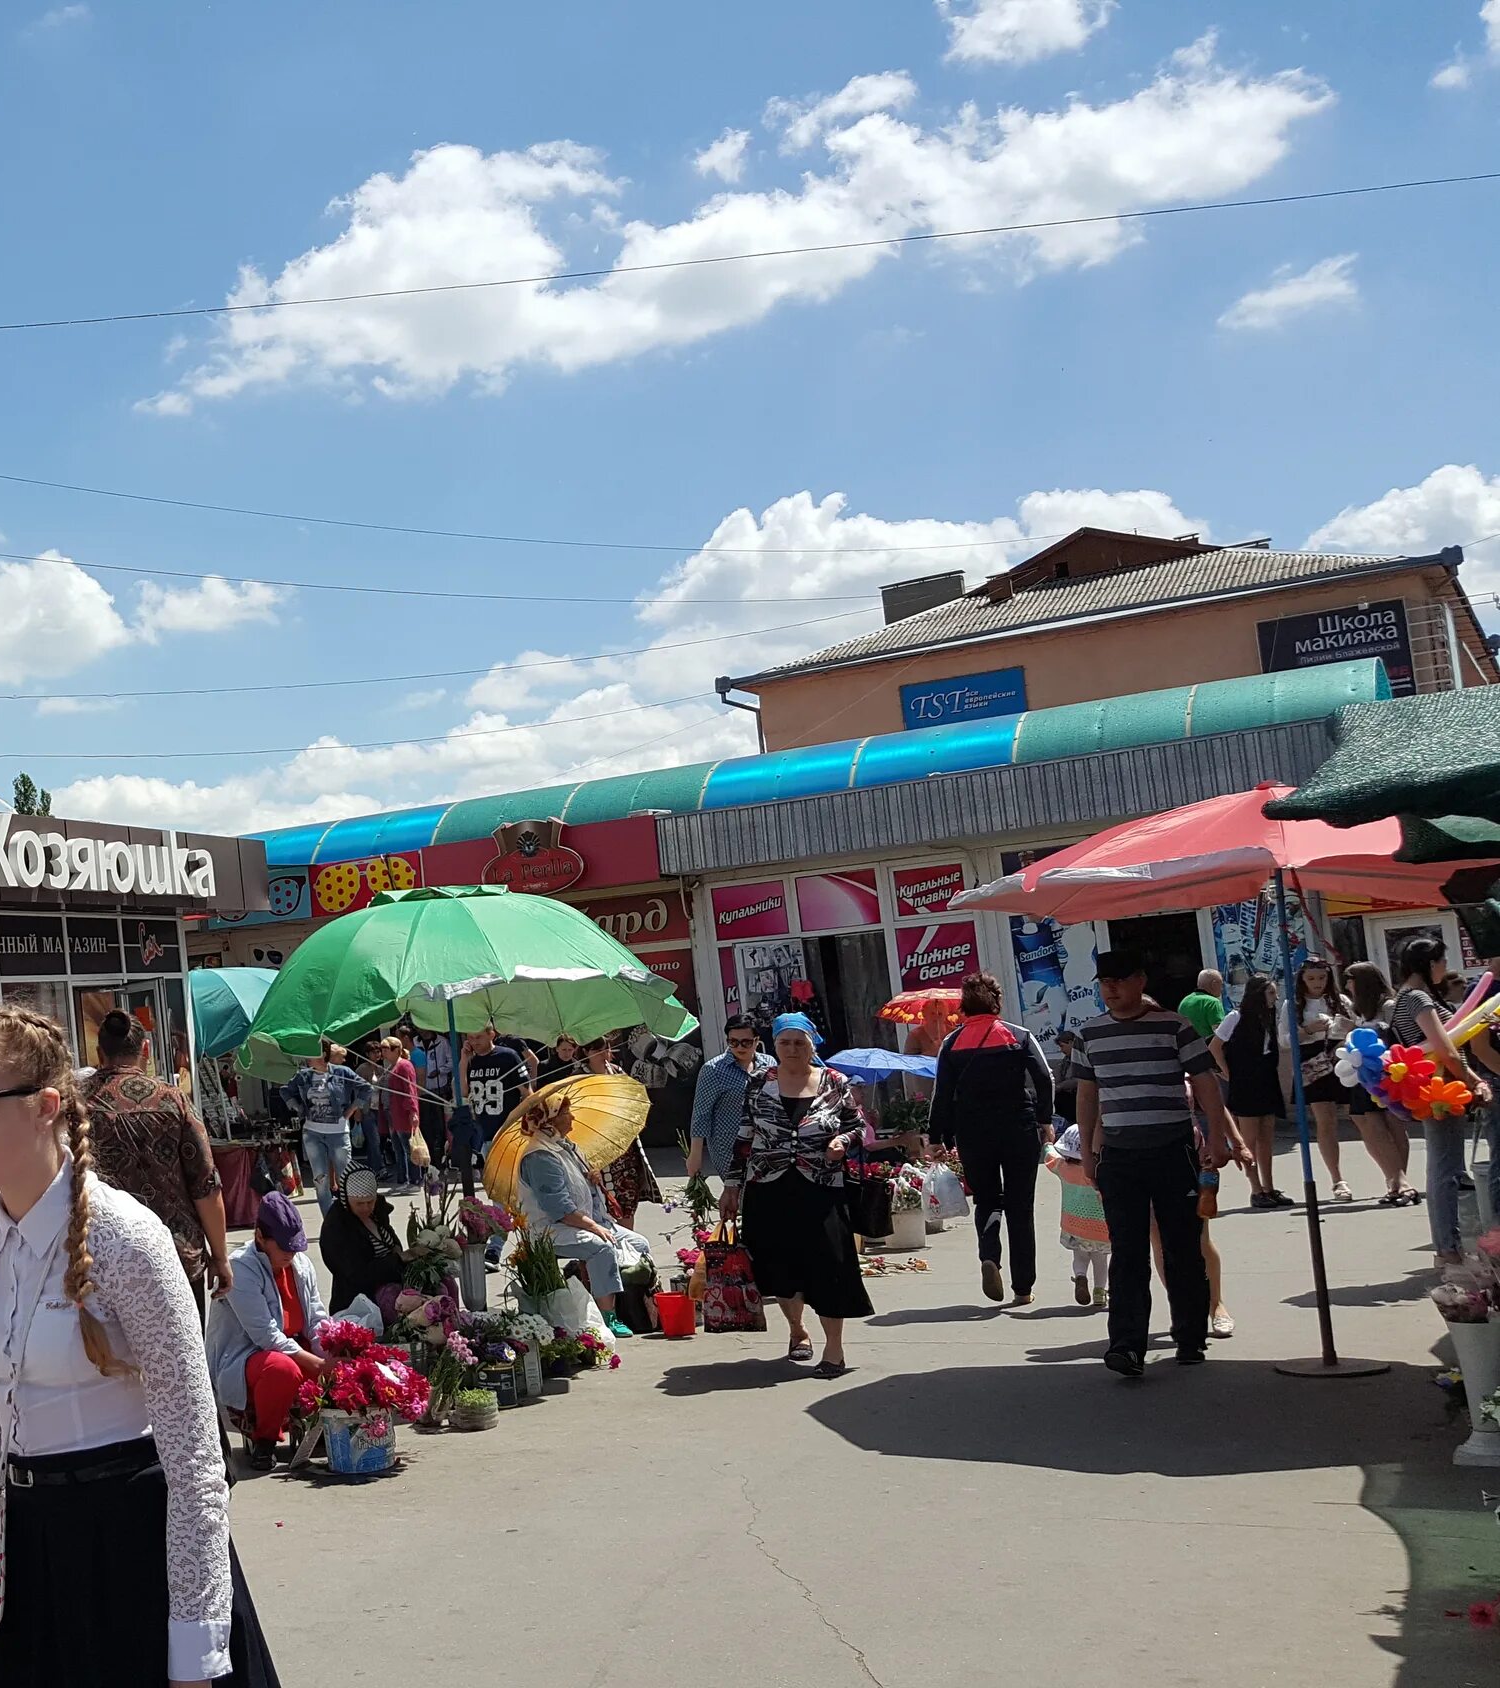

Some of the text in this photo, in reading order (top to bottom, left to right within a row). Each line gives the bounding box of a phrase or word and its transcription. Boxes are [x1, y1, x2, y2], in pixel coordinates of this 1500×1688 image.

[1318, 610, 1396, 634] Школа
[1295, 625, 1398, 654] макияжа
[911, 687, 968, 719] TST
[899, 871, 961, 898] Купальные
[718, 895, 782, 925] Купальники
[913, 888, 952, 908] плавки
[905, 943, 971, 969] Нижнее
[919, 960, 965, 981] белье
[470, 1068, 501, 1078] BAD BOY
